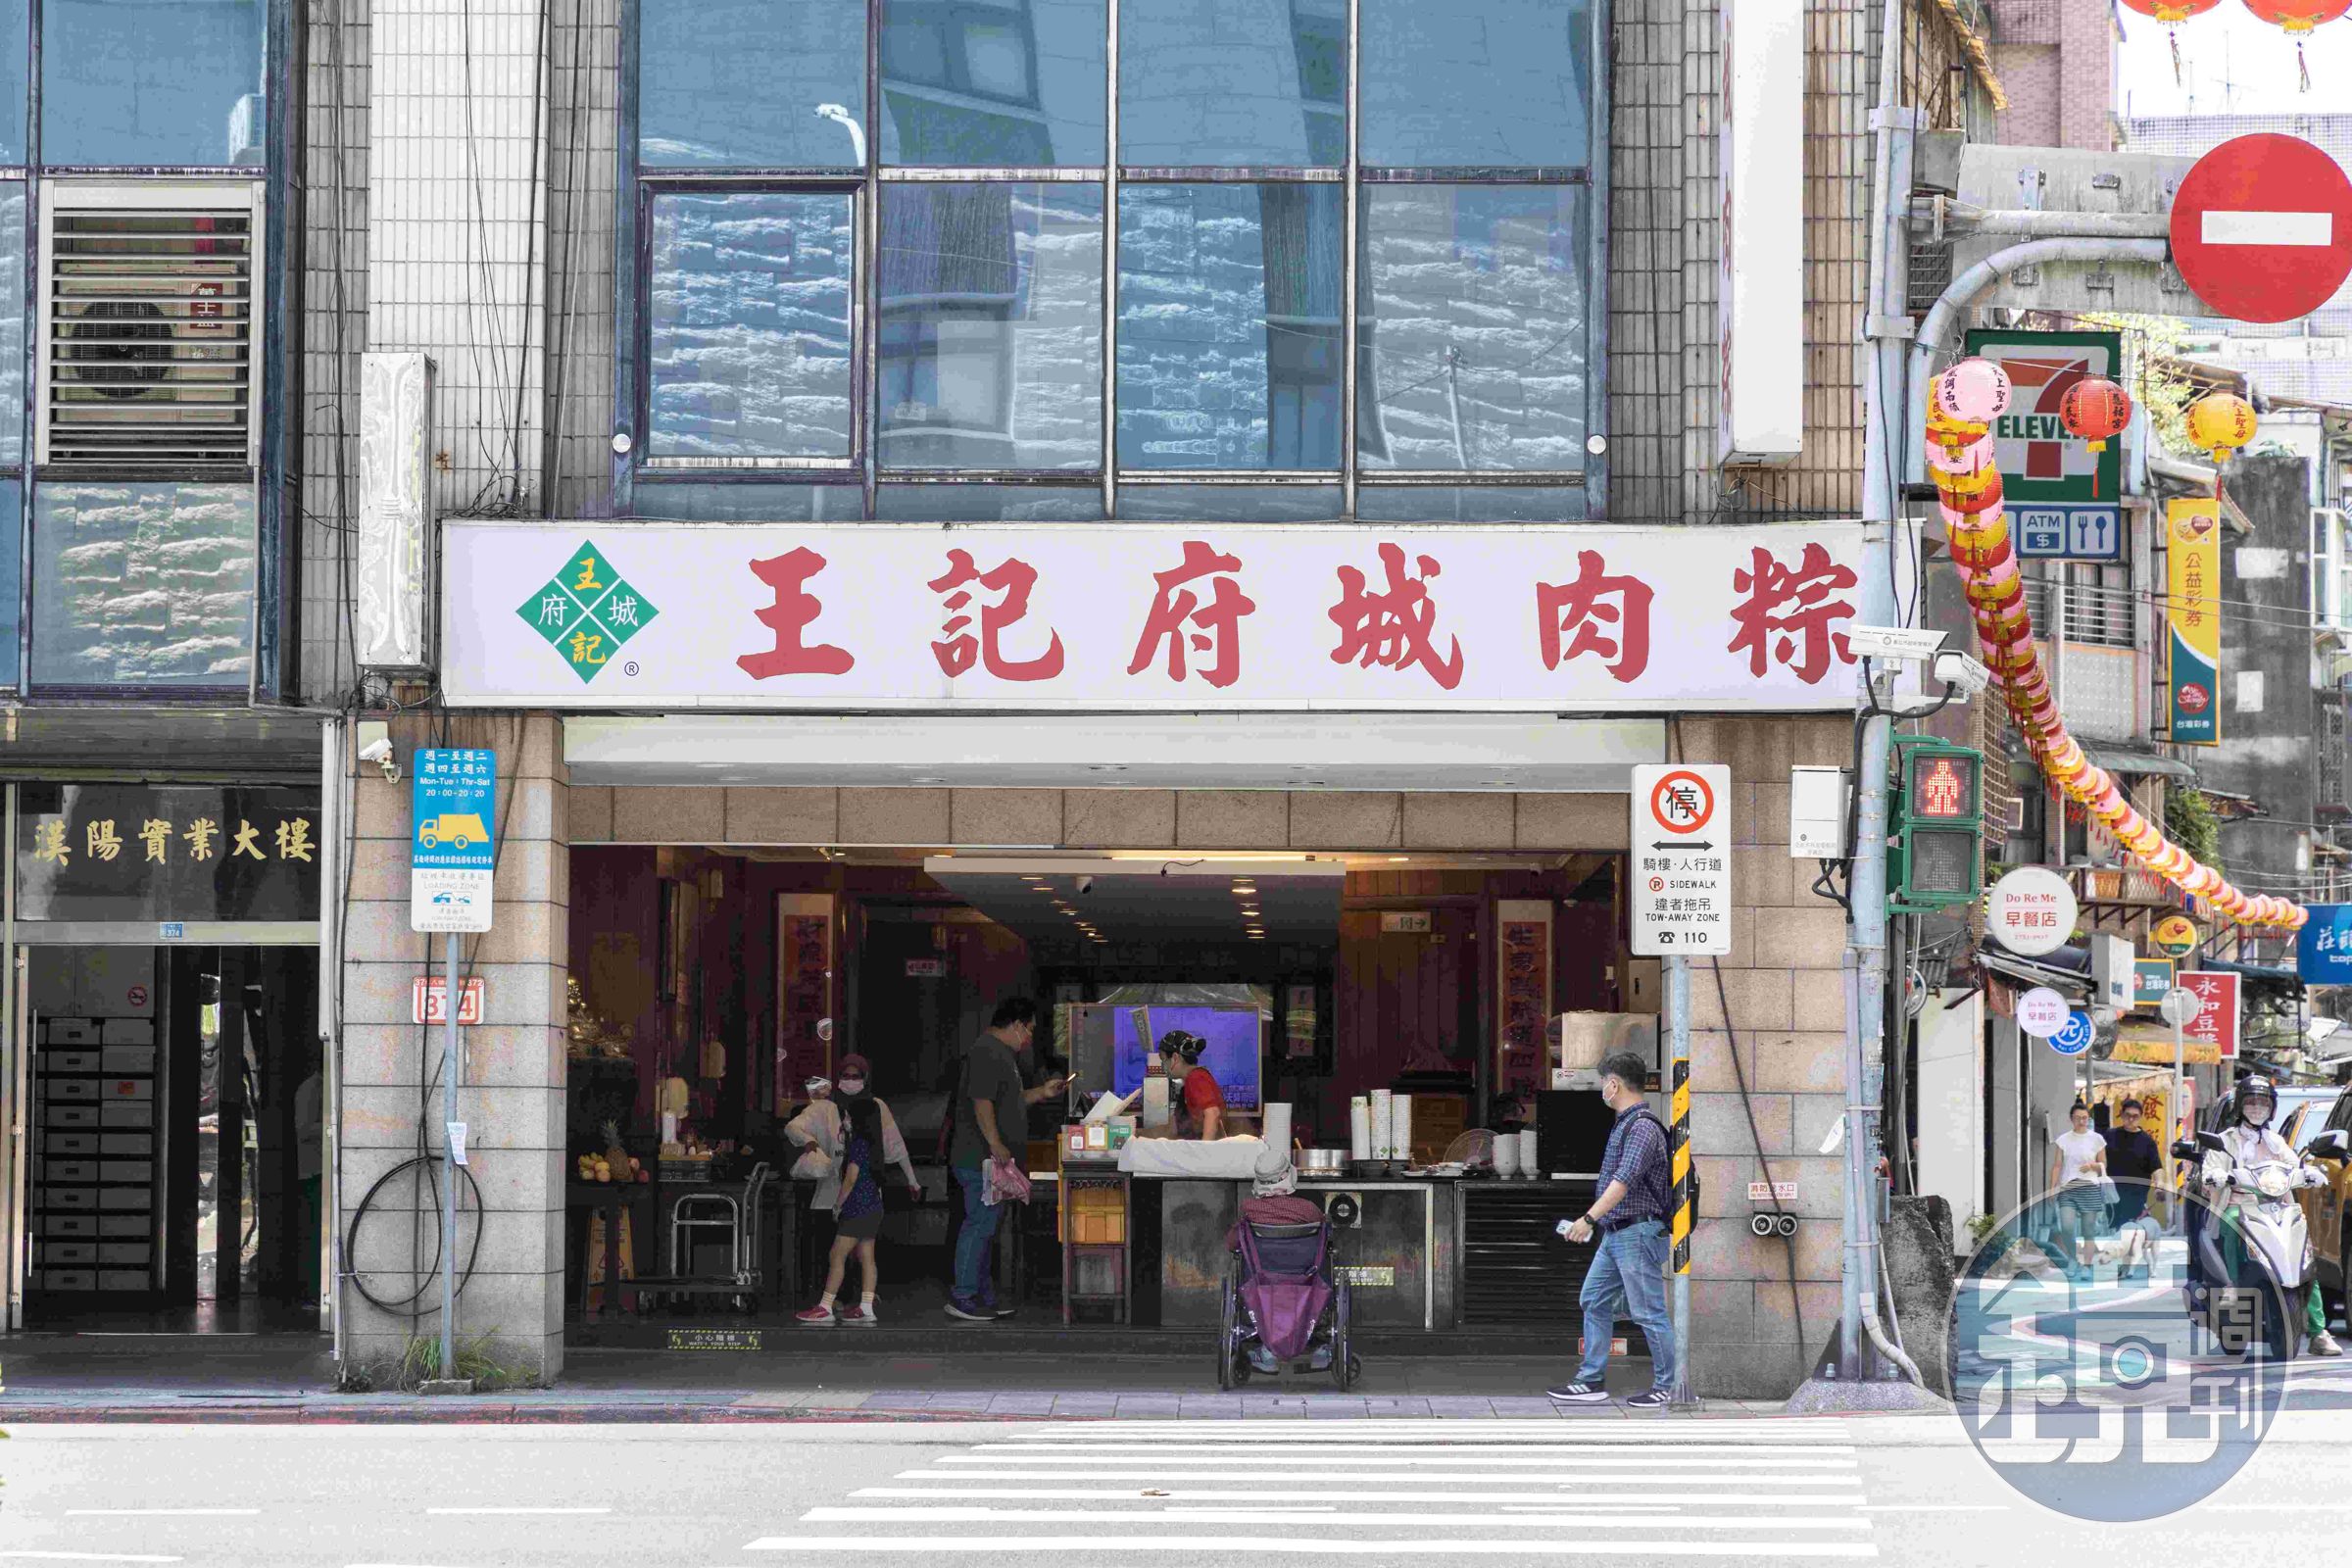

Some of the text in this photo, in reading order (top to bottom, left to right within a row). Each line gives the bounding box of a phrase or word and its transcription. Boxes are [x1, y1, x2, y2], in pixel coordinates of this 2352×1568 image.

[1997, 416, 2087, 439] ELEVE
[2027, 515, 2060, 527] ATM
[574, 557, 603, 591] 王
[2184, 552, 2203, 627] 公益彩券
[538, 593, 639, 627] 府 城
[735, 540, 1858, 690] 王記府城肉粽
[569, 631, 607, 664] 記
[424, 750, 488, 761] 週一至週二
[424, 762, 487, 774] 週四至週六
[1665, 786, 1697, 819] 停
[33, 816, 317, 867] 漢陽實業大樓
[1669, 880, 1717, 889] SIDEWALK
[1654, 898, 1711, 912] 違者拖吊
[2006, 893, 2057, 904] Do Re Me
[1644, 912, 1721, 922] TOW-AWAY ZONE
[2005, 911, 2057, 927] 早餐店
[1685, 932, 1708, 944] 110
[424, 995, 472, 1017] 34
